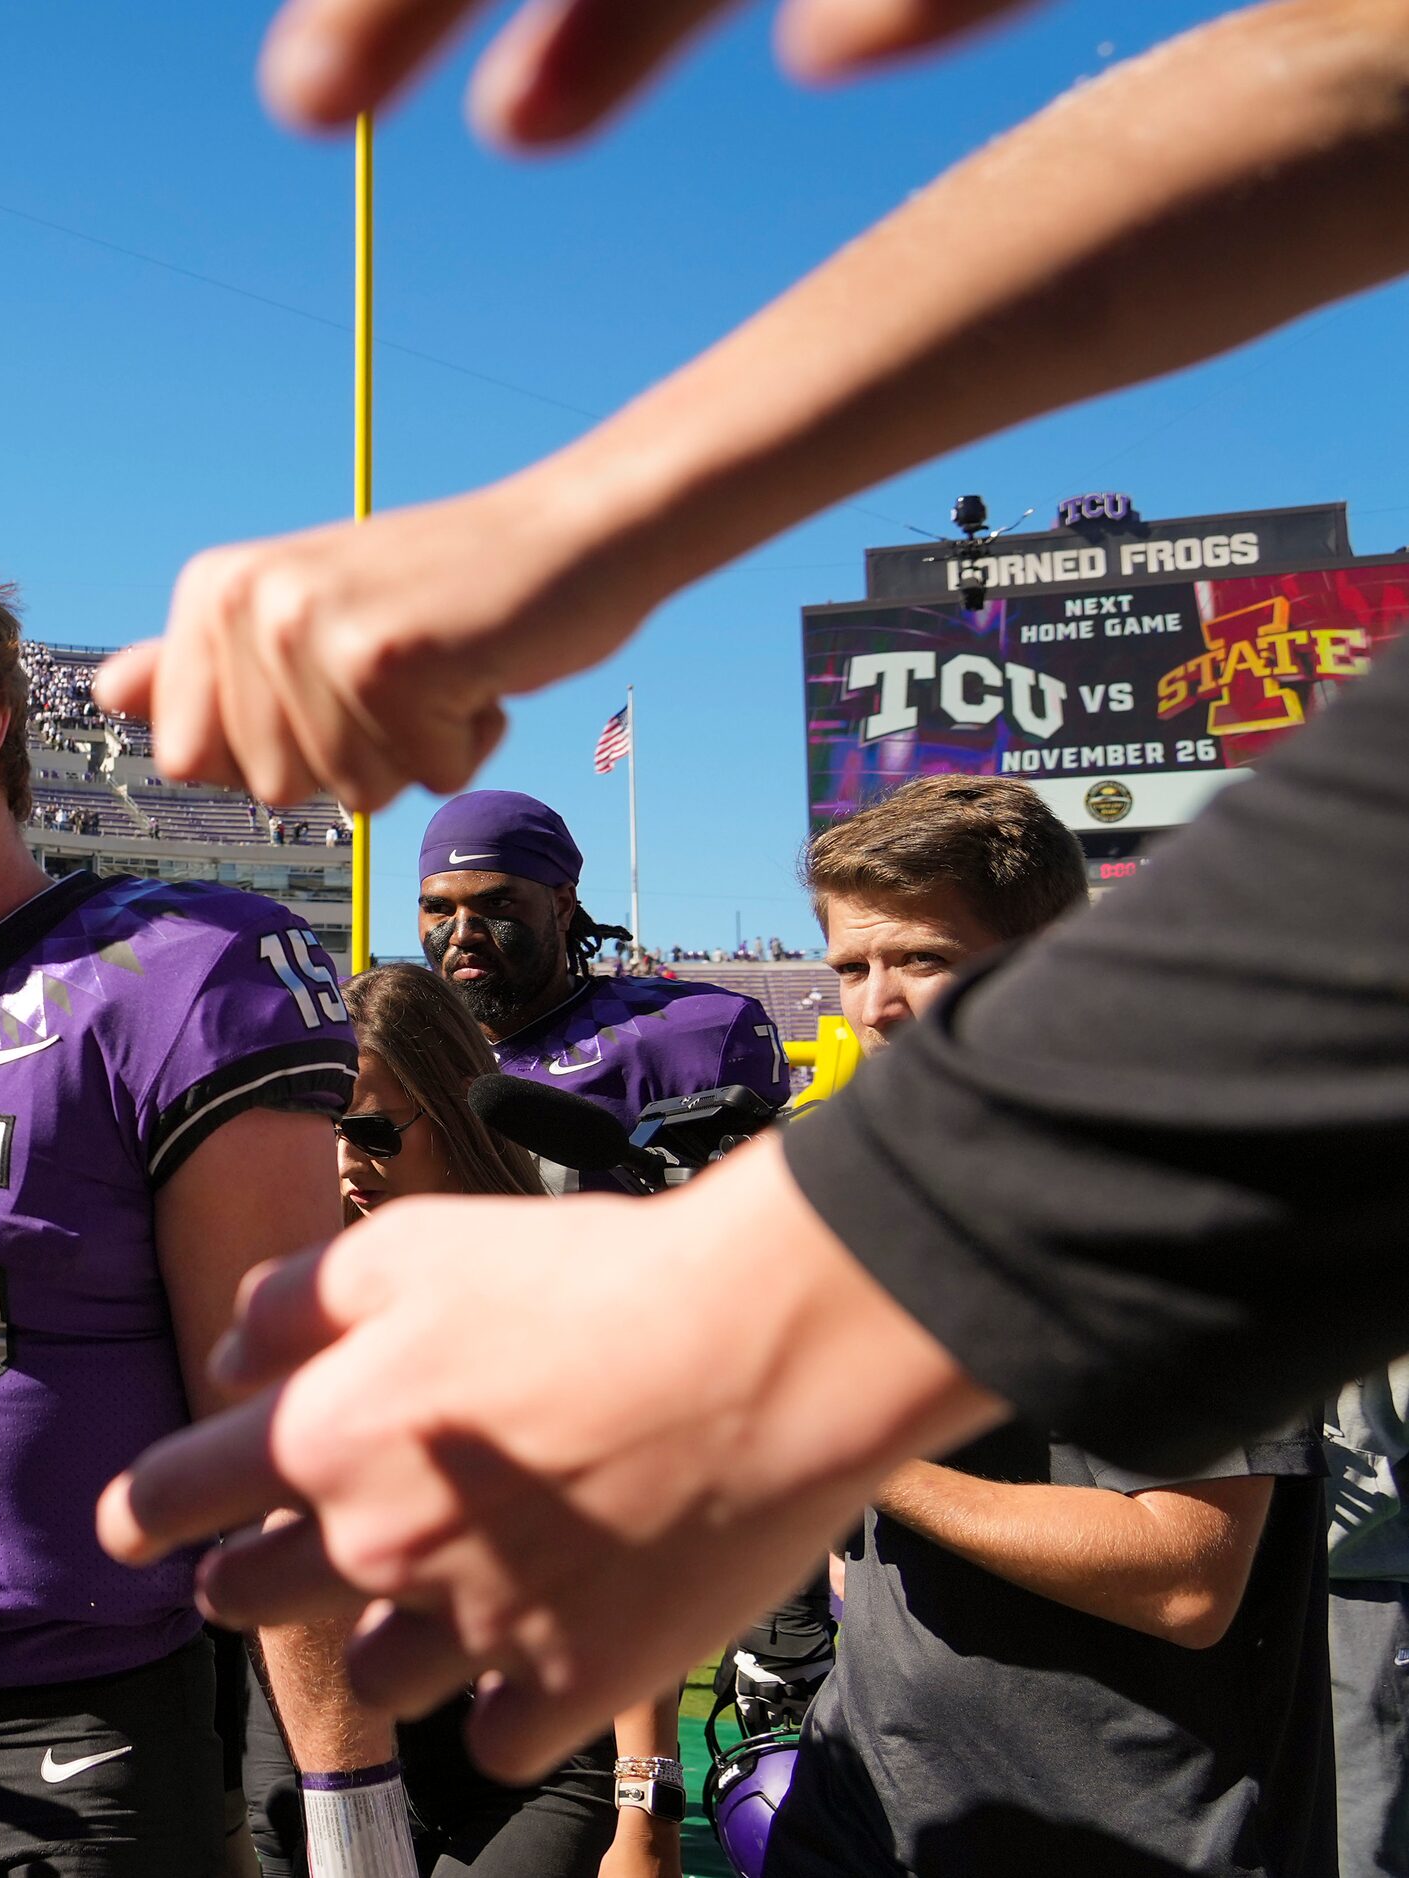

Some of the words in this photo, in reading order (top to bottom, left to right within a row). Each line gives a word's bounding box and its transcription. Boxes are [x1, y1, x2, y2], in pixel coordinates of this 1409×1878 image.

[1059, 492, 1130, 525] TCU
[1120, 532, 1259, 575] FROGS
[1065, 595, 1134, 617] NEXT
[1021, 620, 1094, 644] HOME
[1104, 613, 1183, 637] GAME
[1156, 627, 1371, 720] STATE
[847, 650, 1068, 742] TCU
[1078, 682, 1134, 713] VS
[1002, 742, 1165, 773] NOVEMBER
[1176, 739, 1217, 762] 26
[259, 927, 349, 1029] 15
[752, 1024, 790, 1084] 7
